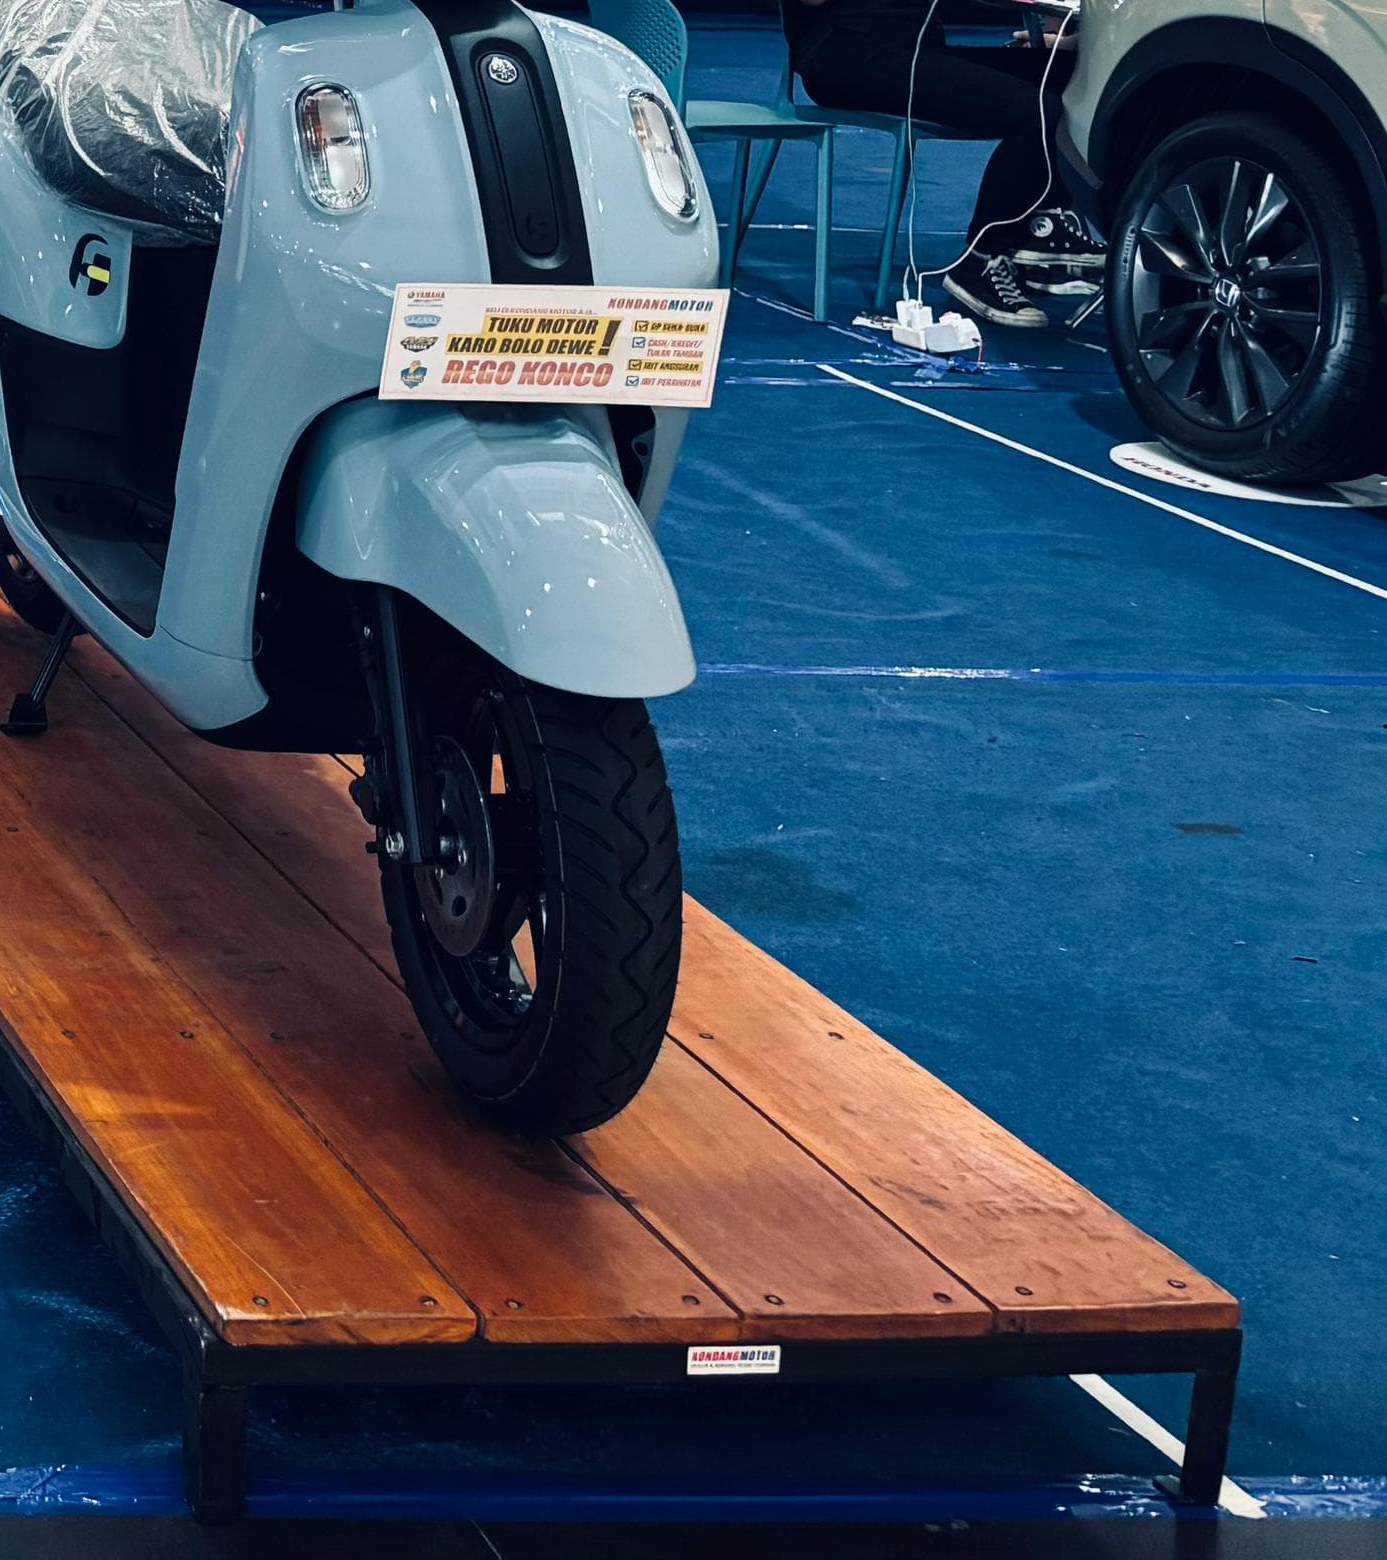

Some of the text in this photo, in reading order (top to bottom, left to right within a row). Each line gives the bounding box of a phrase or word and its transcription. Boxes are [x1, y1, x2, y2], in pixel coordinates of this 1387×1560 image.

[488, 317, 599, 335] TUKU MOTOR
[447, 337, 497, 354] KARO
[498, 338, 544, 354] BOLO
[545, 339, 596, 355] DEWE
[442, 359, 516, 385] REGO
[517, 361, 614, 387] KONCO
